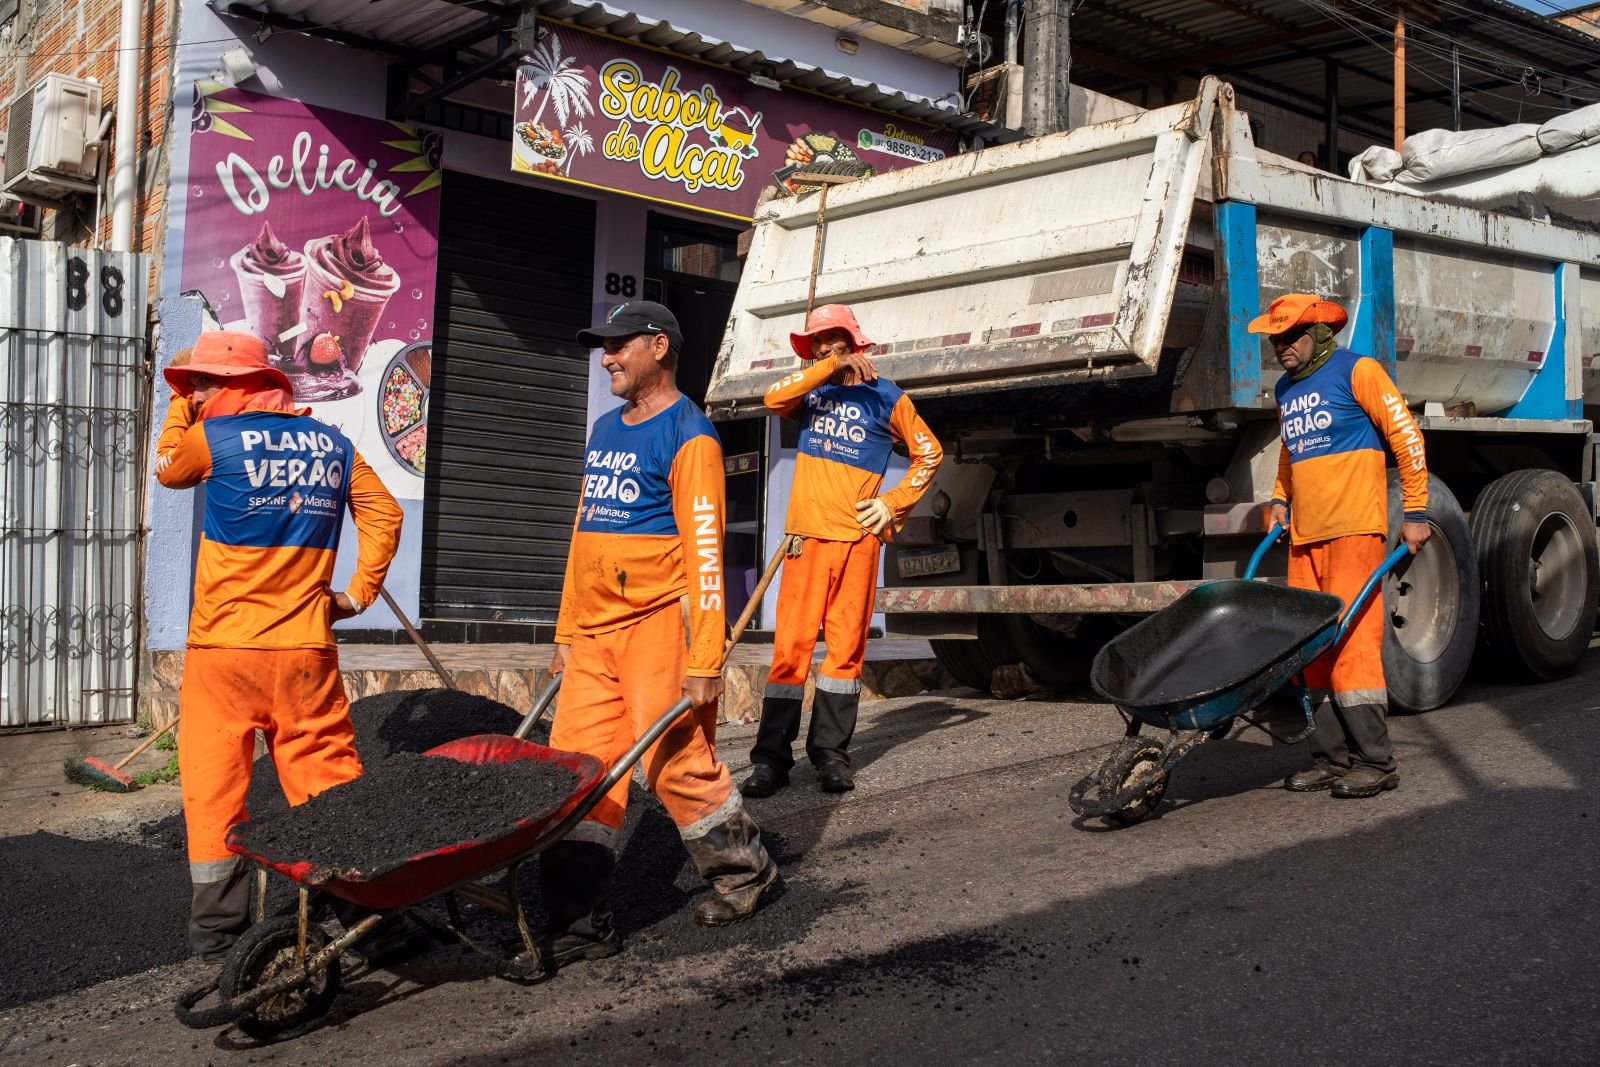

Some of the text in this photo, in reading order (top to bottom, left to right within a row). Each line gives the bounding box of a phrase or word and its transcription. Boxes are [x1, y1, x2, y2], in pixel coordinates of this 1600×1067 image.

[601, 60, 723, 133] Sabor
[884, 123, 925, 147] Delivery
[604, 120, 743, 190] do Açaí
[215, 131, 402, 218] Delicia
[605, 272, 637, 298] 88
[809, 393, 861, 420] PLANO
[1280, 392, 1321, 419] PLANO
[241, 430, 333, 453] PLANO
[1304, 435, 1331, 447] Manaus
[1382, 393, 1427, 471] SEMINF
[585, 450, 637, 471] PLANO
[832, 441, 860, 456] Manaus
[911, 431, 938, 493] SEMINF
[243, 450, 343, 489] VERÃO
[248, 495, 287, 507] SEMINF
[305, 494, 337, 510] Manaus
[595, 505, 631, 519] Manaus
[693, 496, 722, 611] SEMINF
